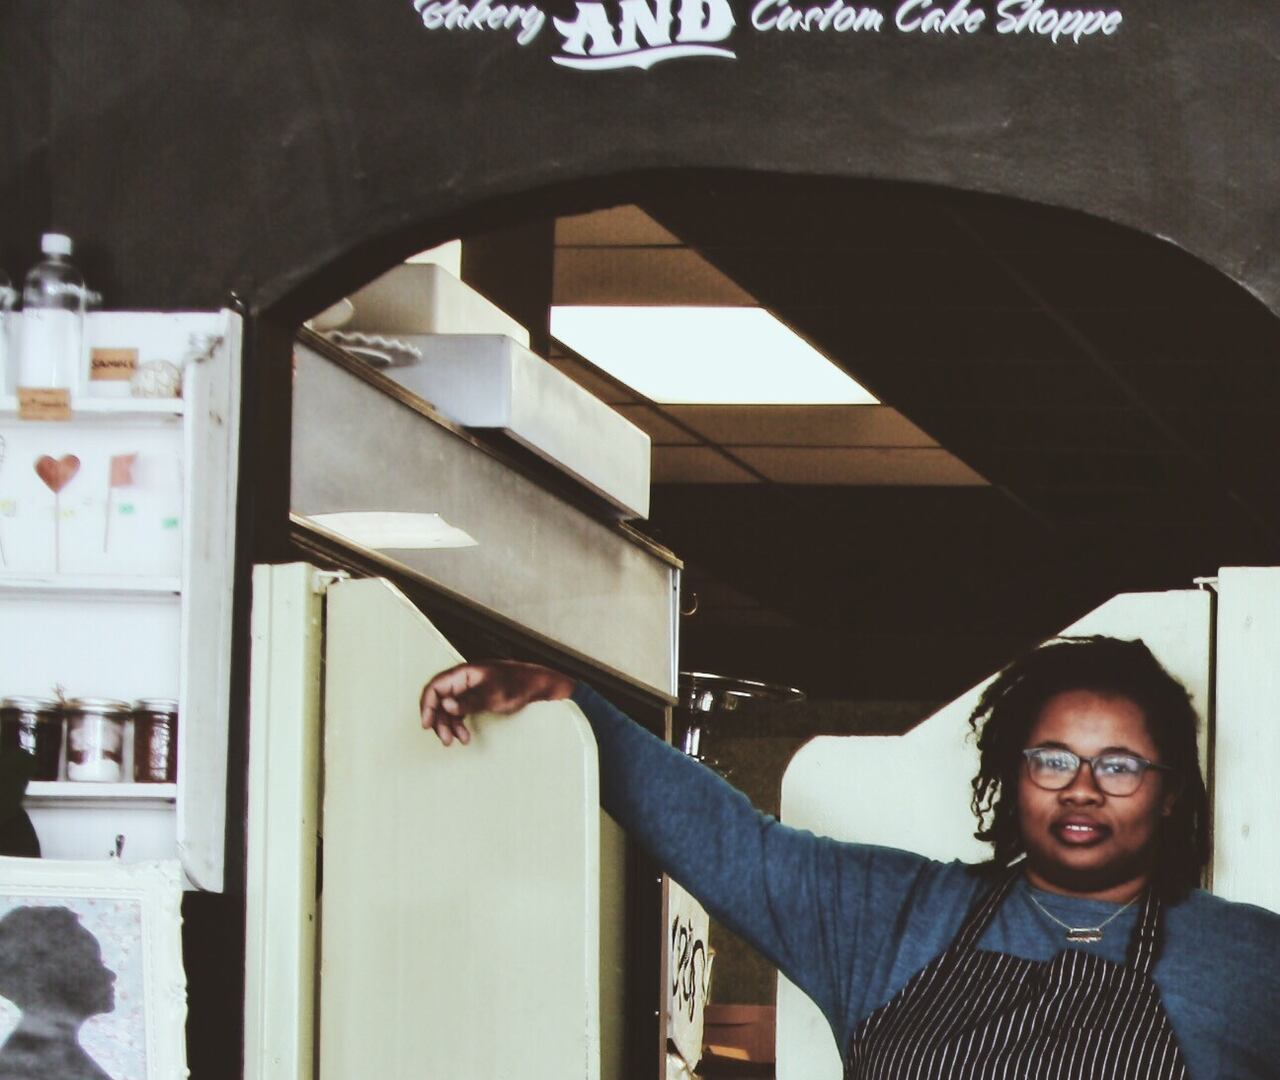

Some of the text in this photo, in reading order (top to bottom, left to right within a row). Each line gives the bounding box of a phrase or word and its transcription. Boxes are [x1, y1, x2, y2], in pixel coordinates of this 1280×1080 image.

[552, 0, 736, 55] AND
[751, 0, 881, 33] Custom
[895, 0, 984, 33] Cake
[997, 0, 1122, 44] Shoppe
